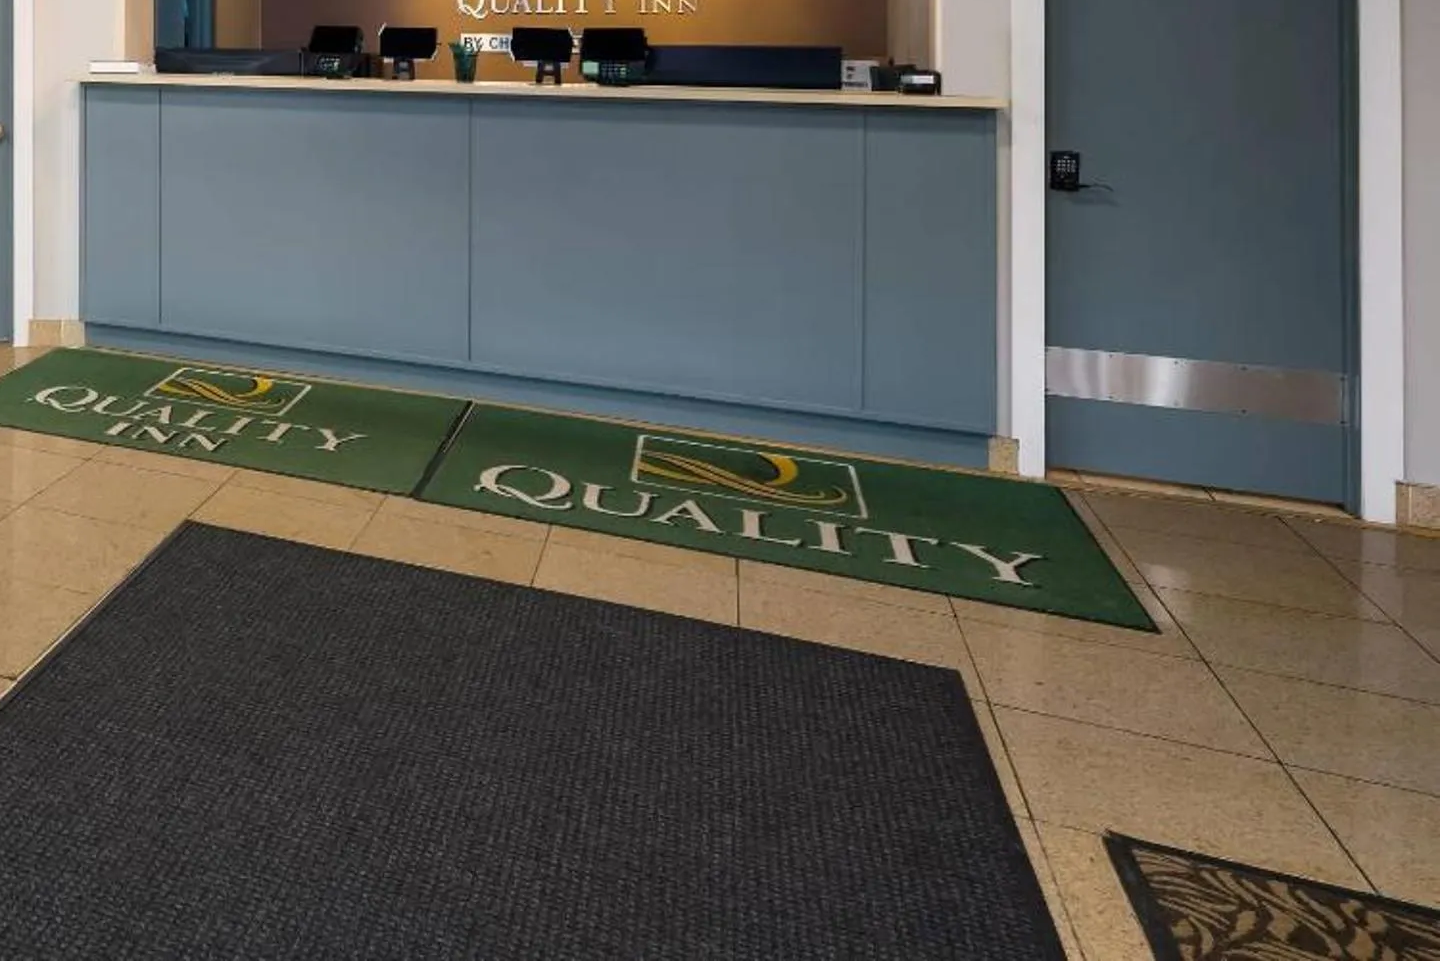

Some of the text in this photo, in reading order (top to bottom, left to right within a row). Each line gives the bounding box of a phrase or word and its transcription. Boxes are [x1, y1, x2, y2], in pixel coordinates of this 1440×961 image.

[27, 385, 367, 452] QUALITY
[103, 421, 228, 452] INN
[473, 464, 1045, 587] QUALITY
